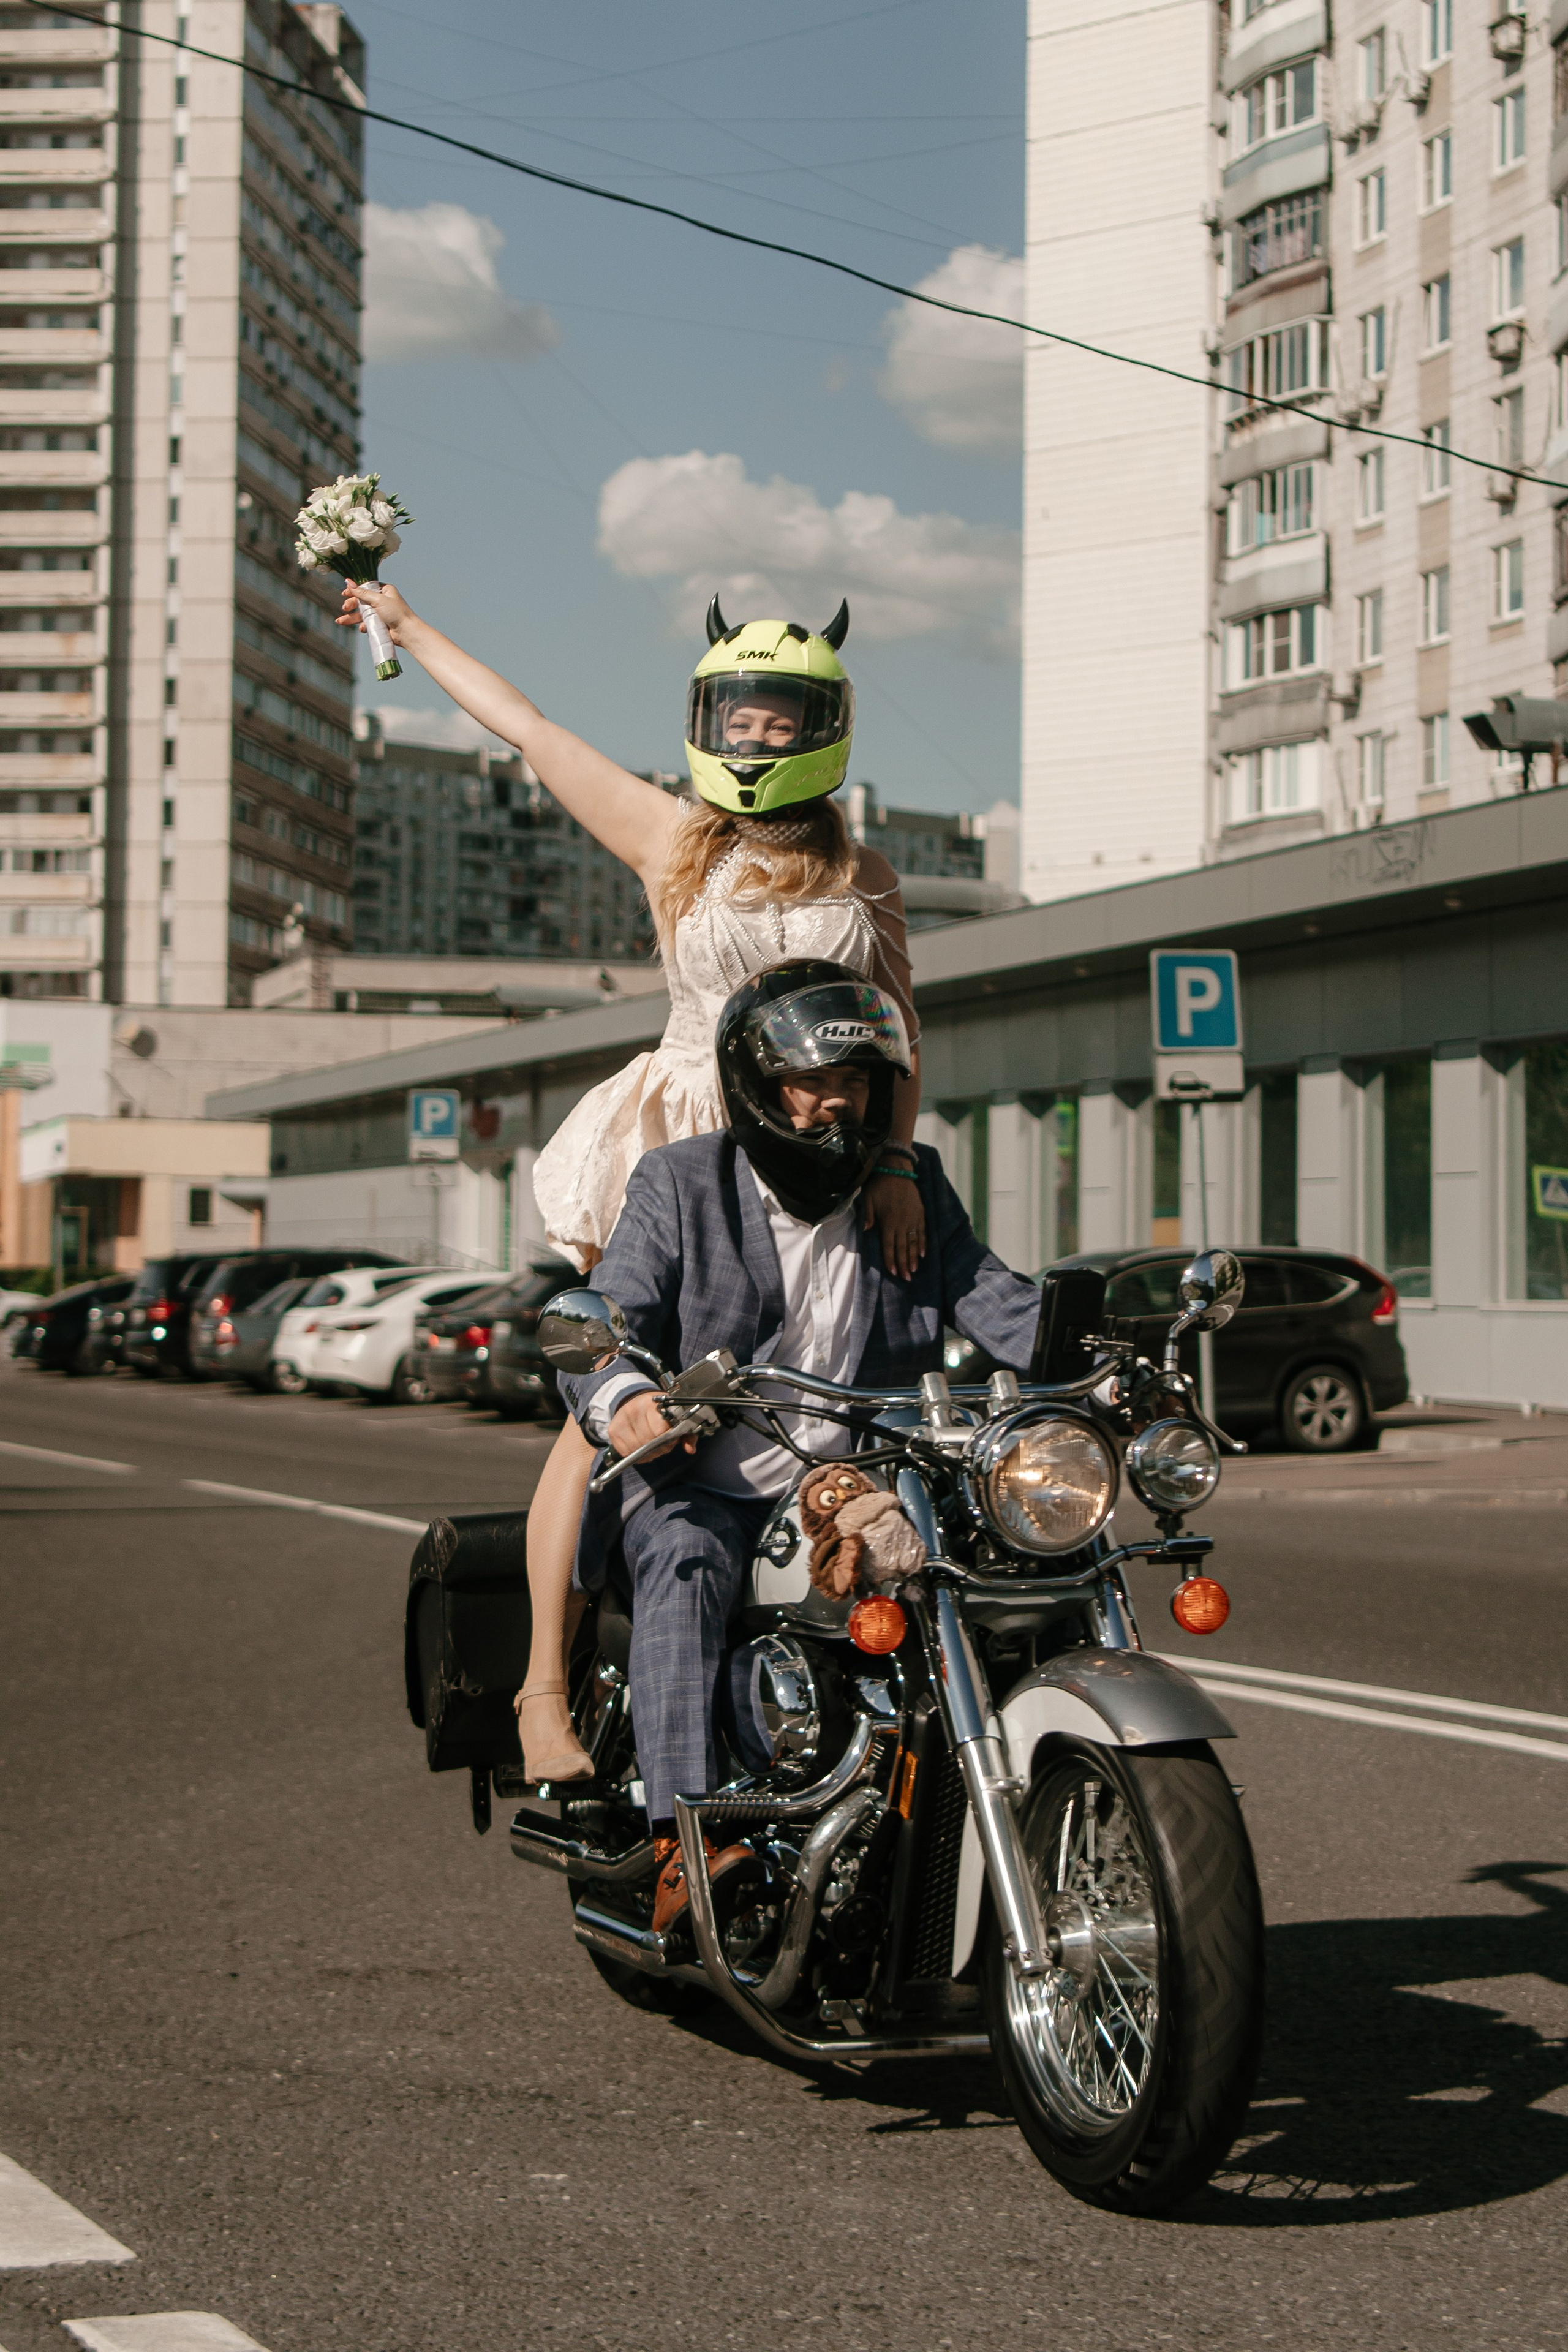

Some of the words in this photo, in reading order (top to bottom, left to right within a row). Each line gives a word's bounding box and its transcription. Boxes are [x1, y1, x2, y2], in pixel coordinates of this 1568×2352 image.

[734, 650, 779, 662] SMK
[1175, 966, 1221, 1037] P
[821, 1025, 871, 1038] HJC
[421, 1097, 450, 1133] P
